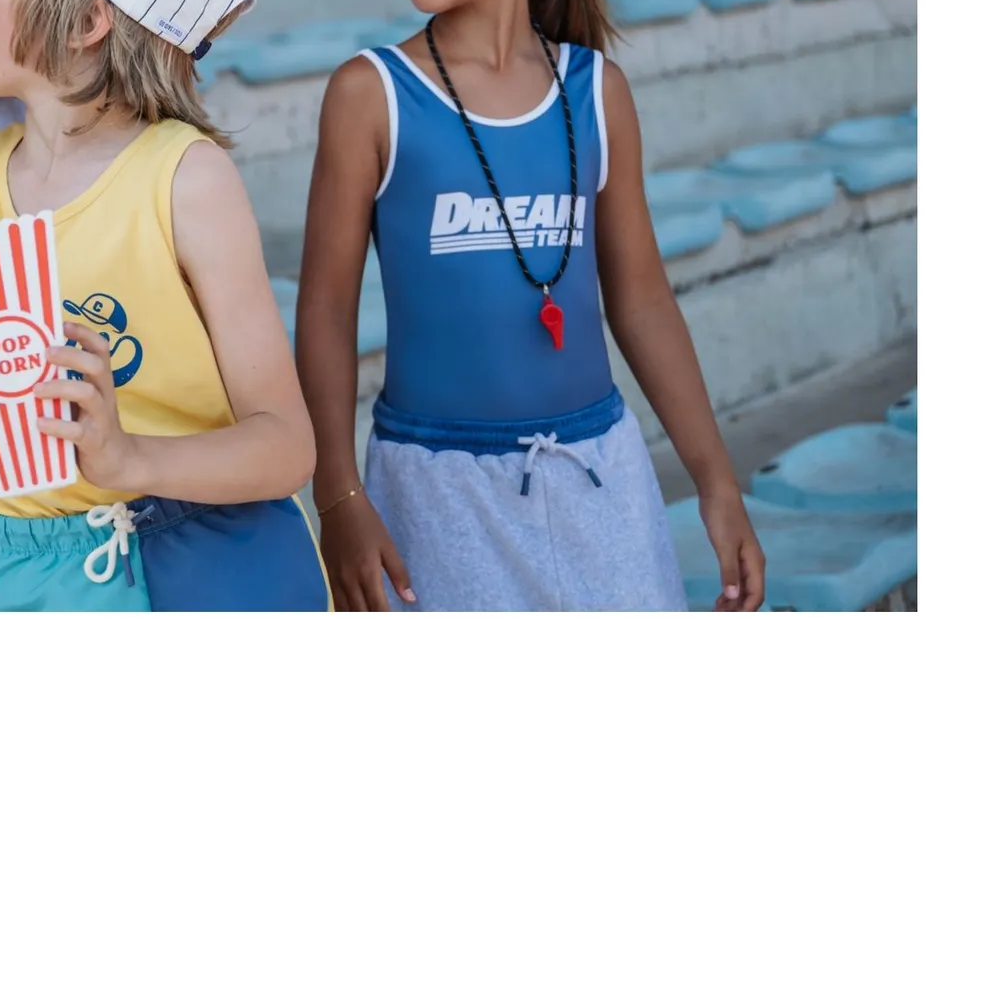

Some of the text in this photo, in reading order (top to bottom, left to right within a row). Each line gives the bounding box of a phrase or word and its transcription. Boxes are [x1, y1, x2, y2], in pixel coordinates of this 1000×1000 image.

[430, 191, 587, 236] DREAM
[536, 229, 584, 247] TEAM
[92, 300, 104, 313] C
